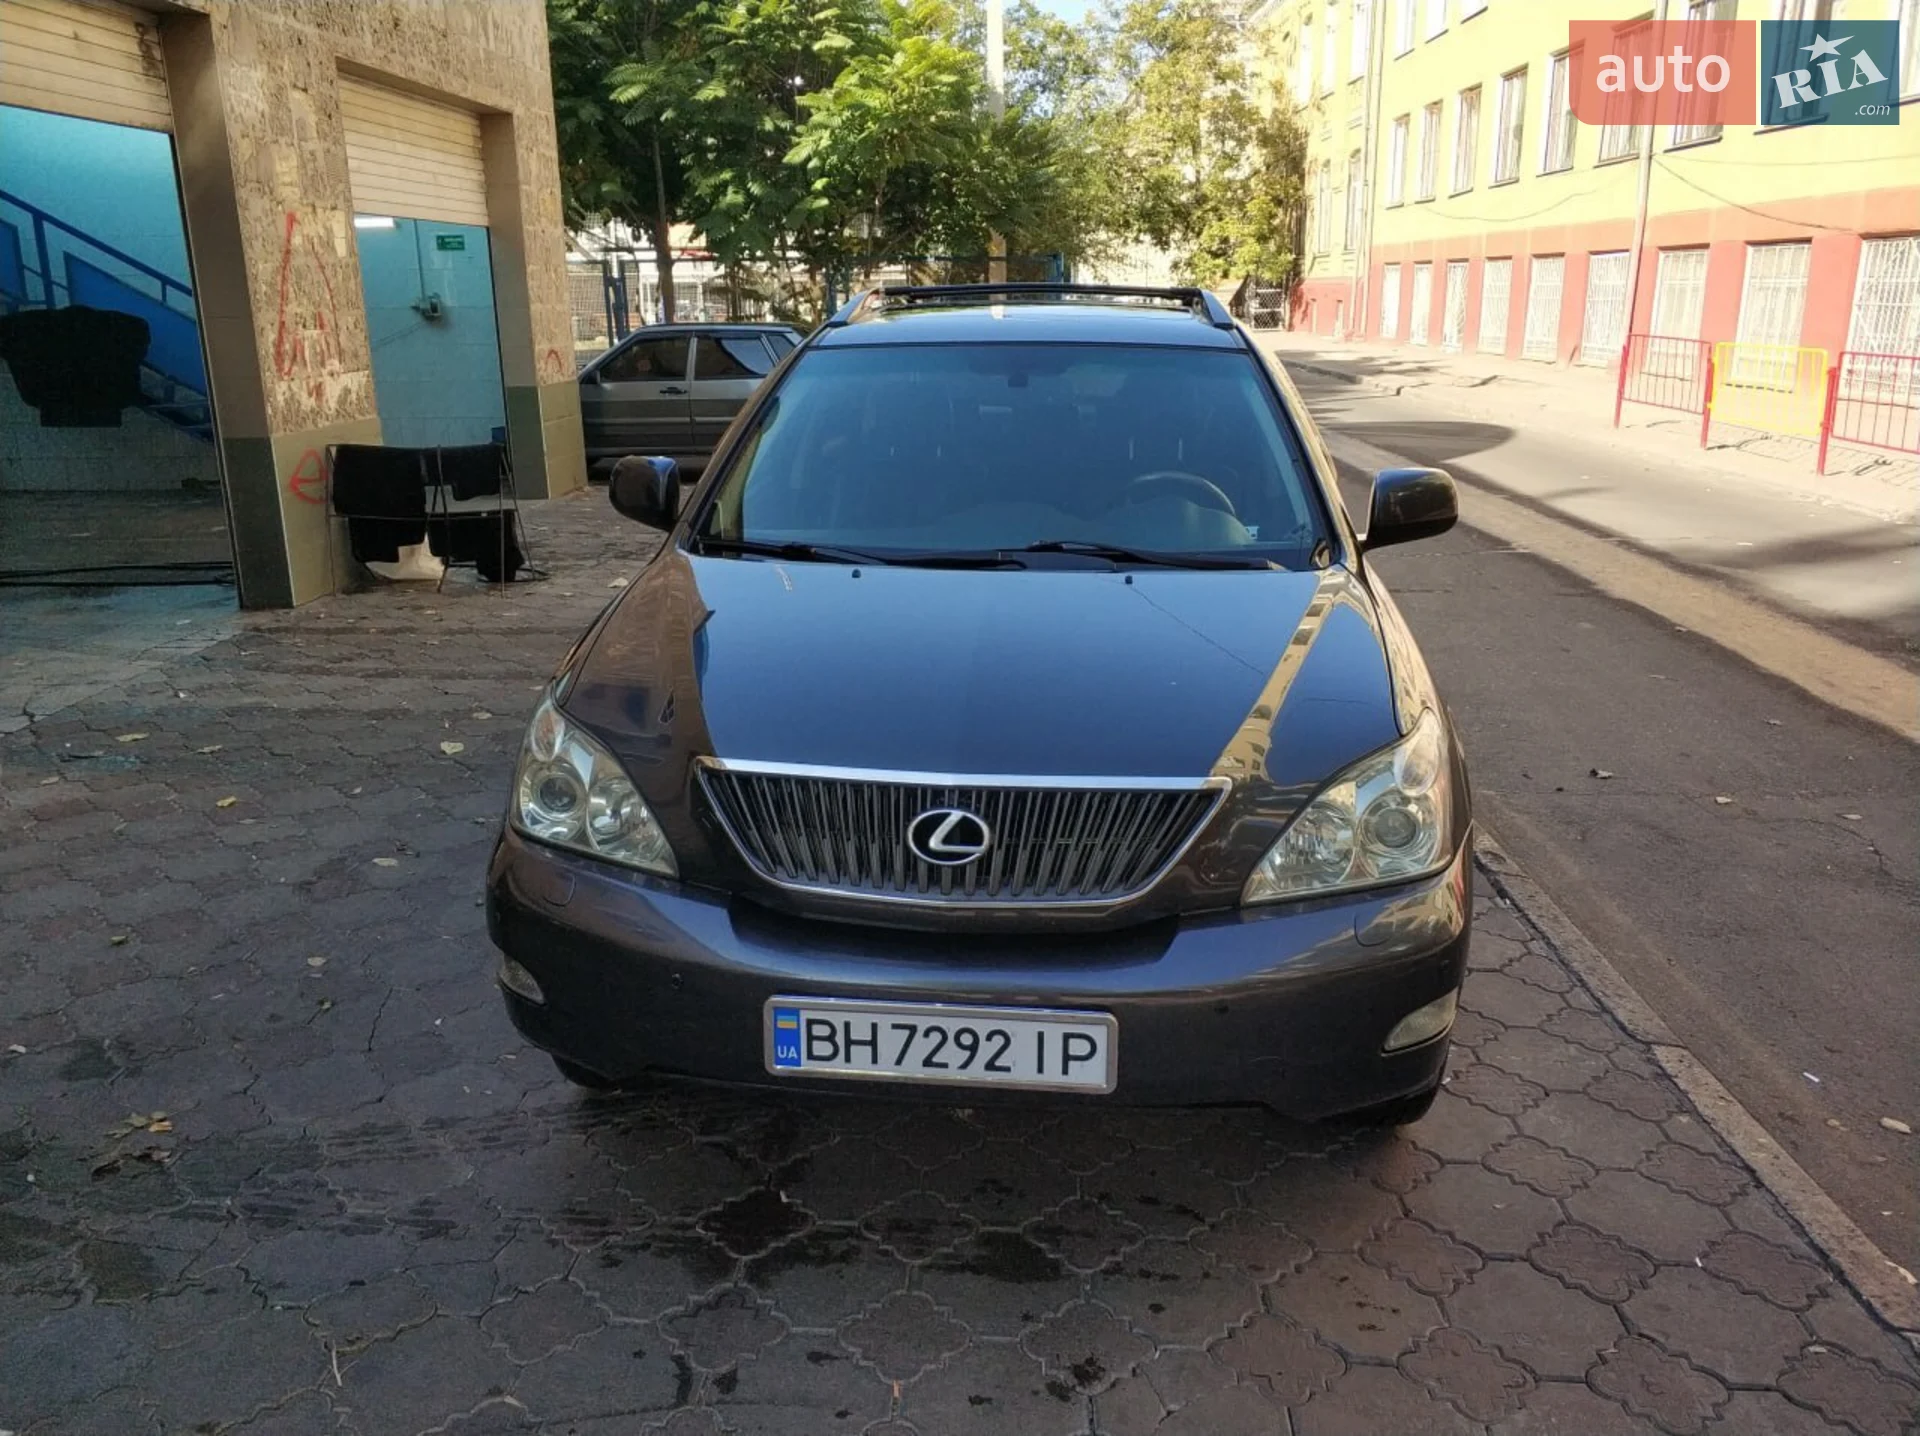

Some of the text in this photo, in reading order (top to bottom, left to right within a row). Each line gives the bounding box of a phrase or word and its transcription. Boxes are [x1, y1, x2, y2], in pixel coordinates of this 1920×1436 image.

[777, 1044, 798, 1059] UA
[806, 1018, 1098, 1076] BH 7292 IP
